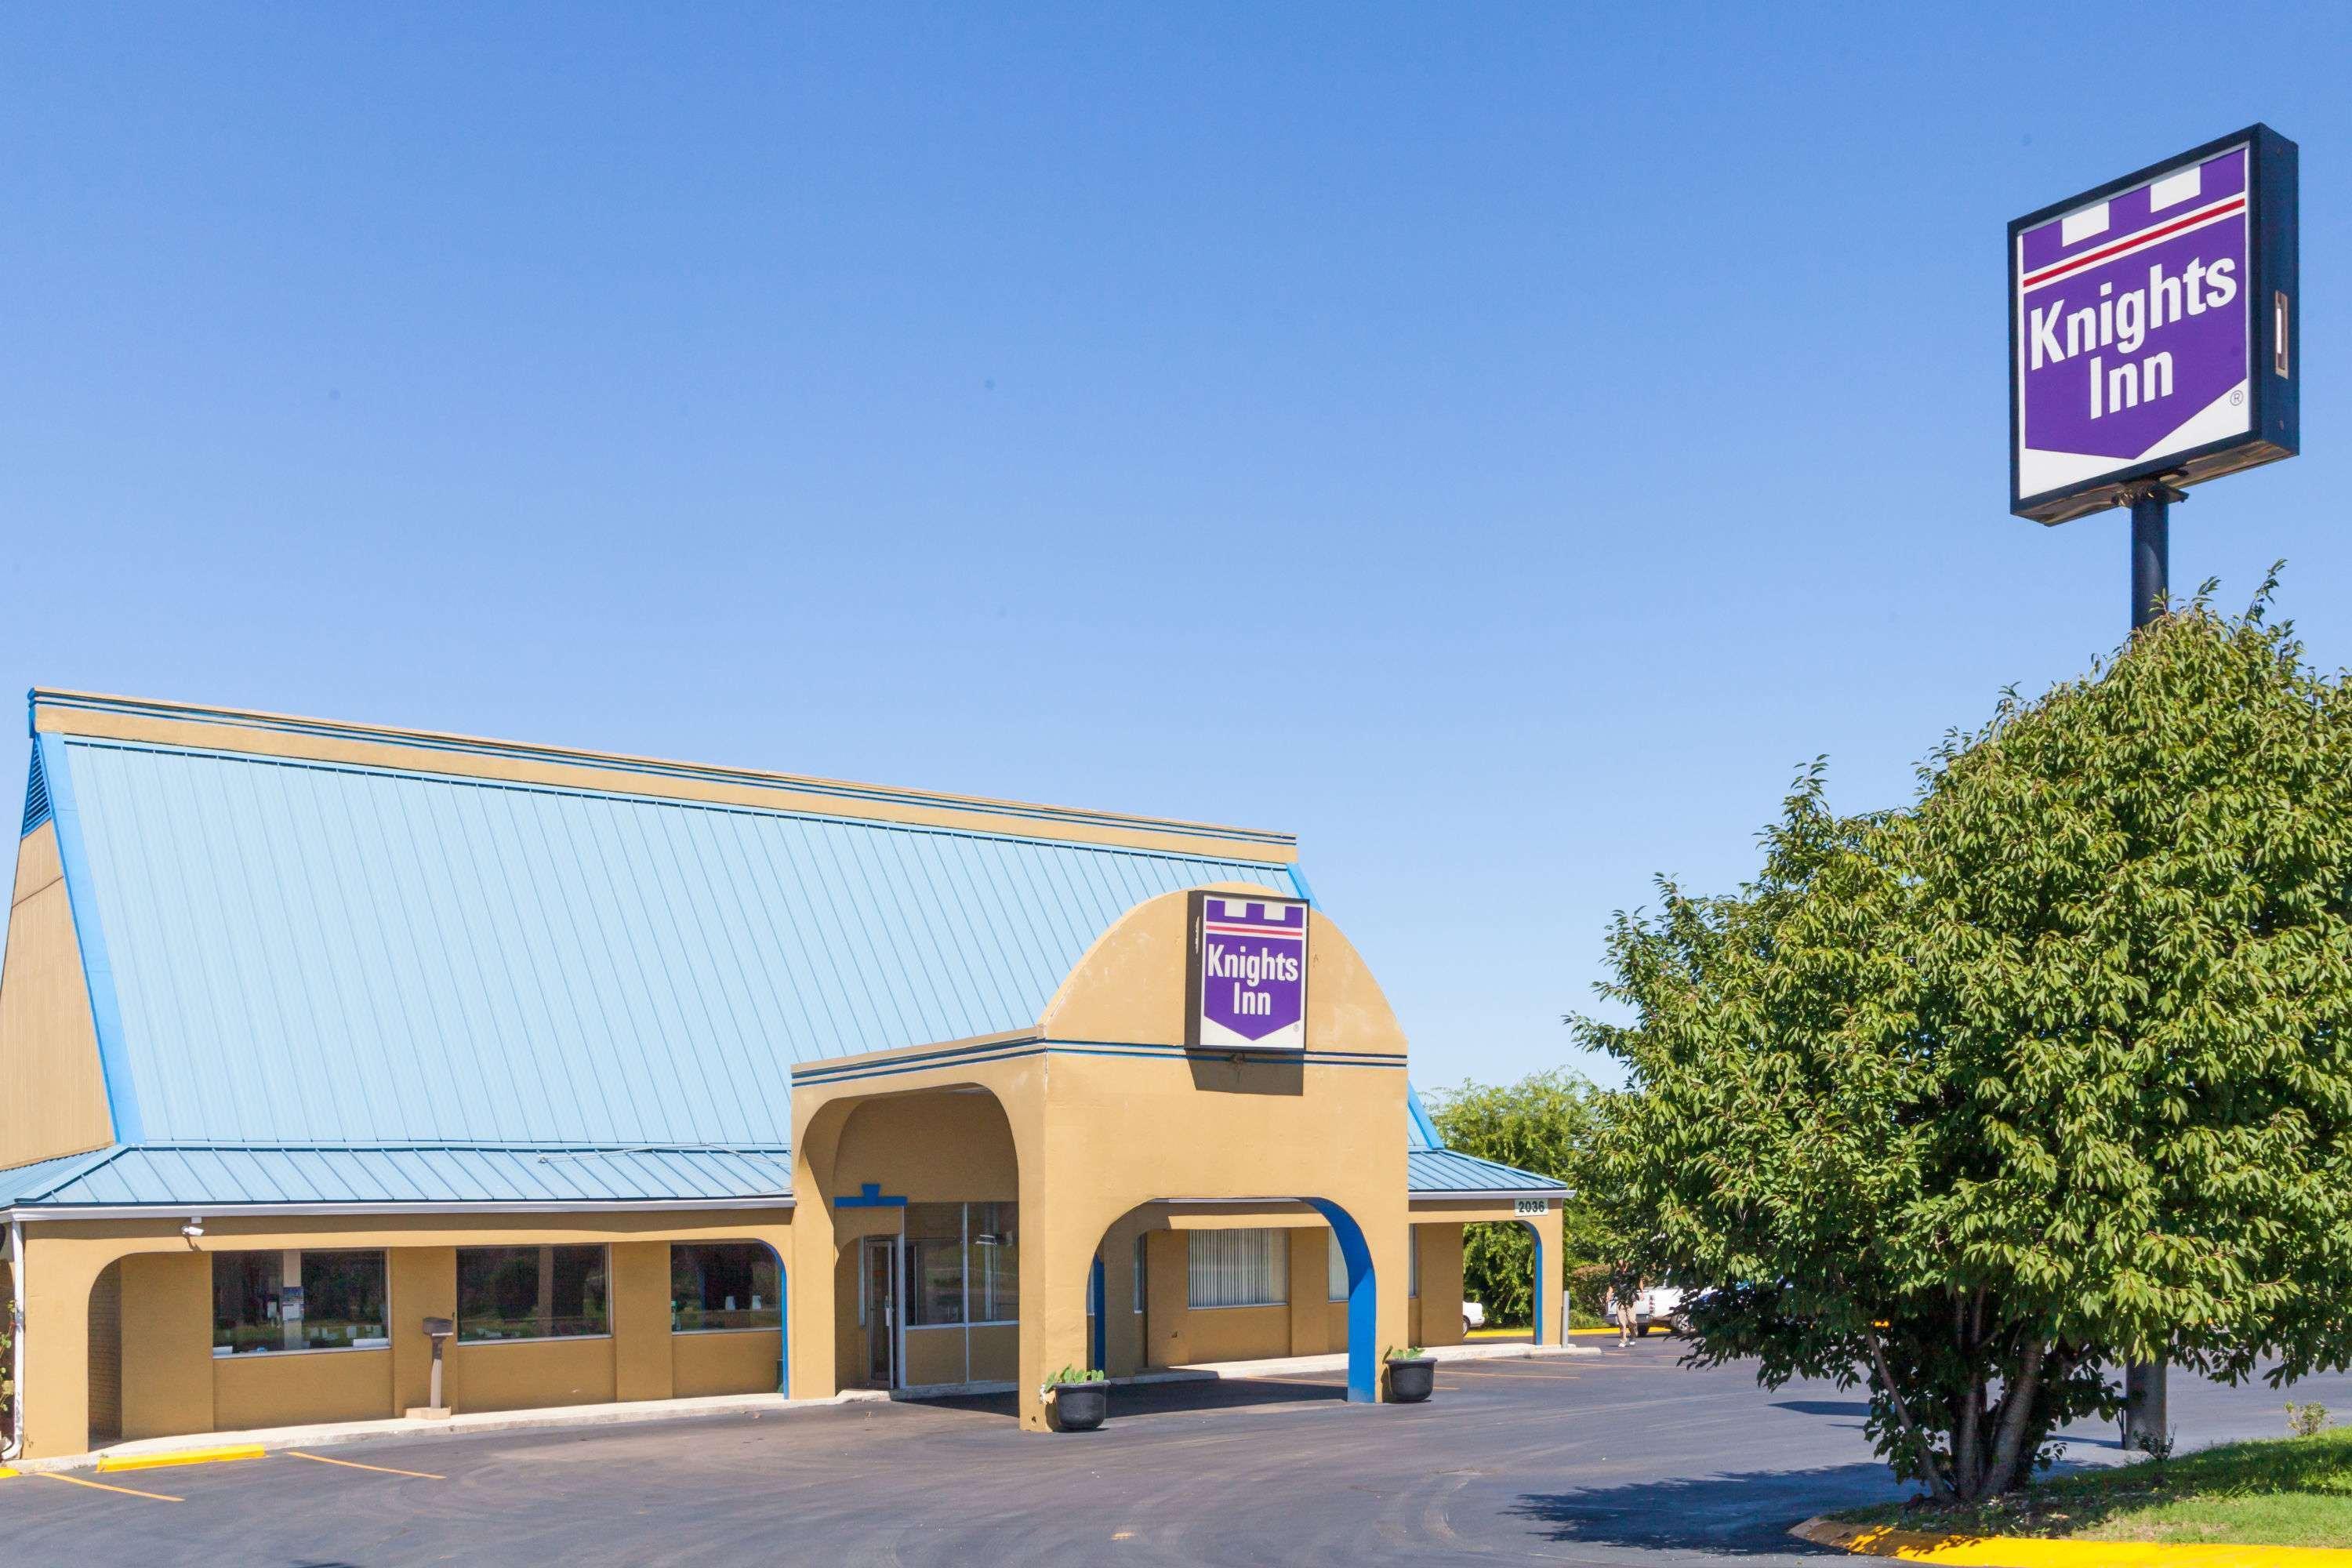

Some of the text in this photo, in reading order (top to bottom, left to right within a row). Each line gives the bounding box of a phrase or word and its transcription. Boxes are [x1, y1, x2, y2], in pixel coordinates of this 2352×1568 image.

[2031, 257, 2237, 371] Knights
[2090, 351, 2173, 420] Inn
[1207, 943, 1298, 987] Knights
[1233, 982, 1271, 1015] Inn
[1519, 1200, 1544, 1213] 2036
